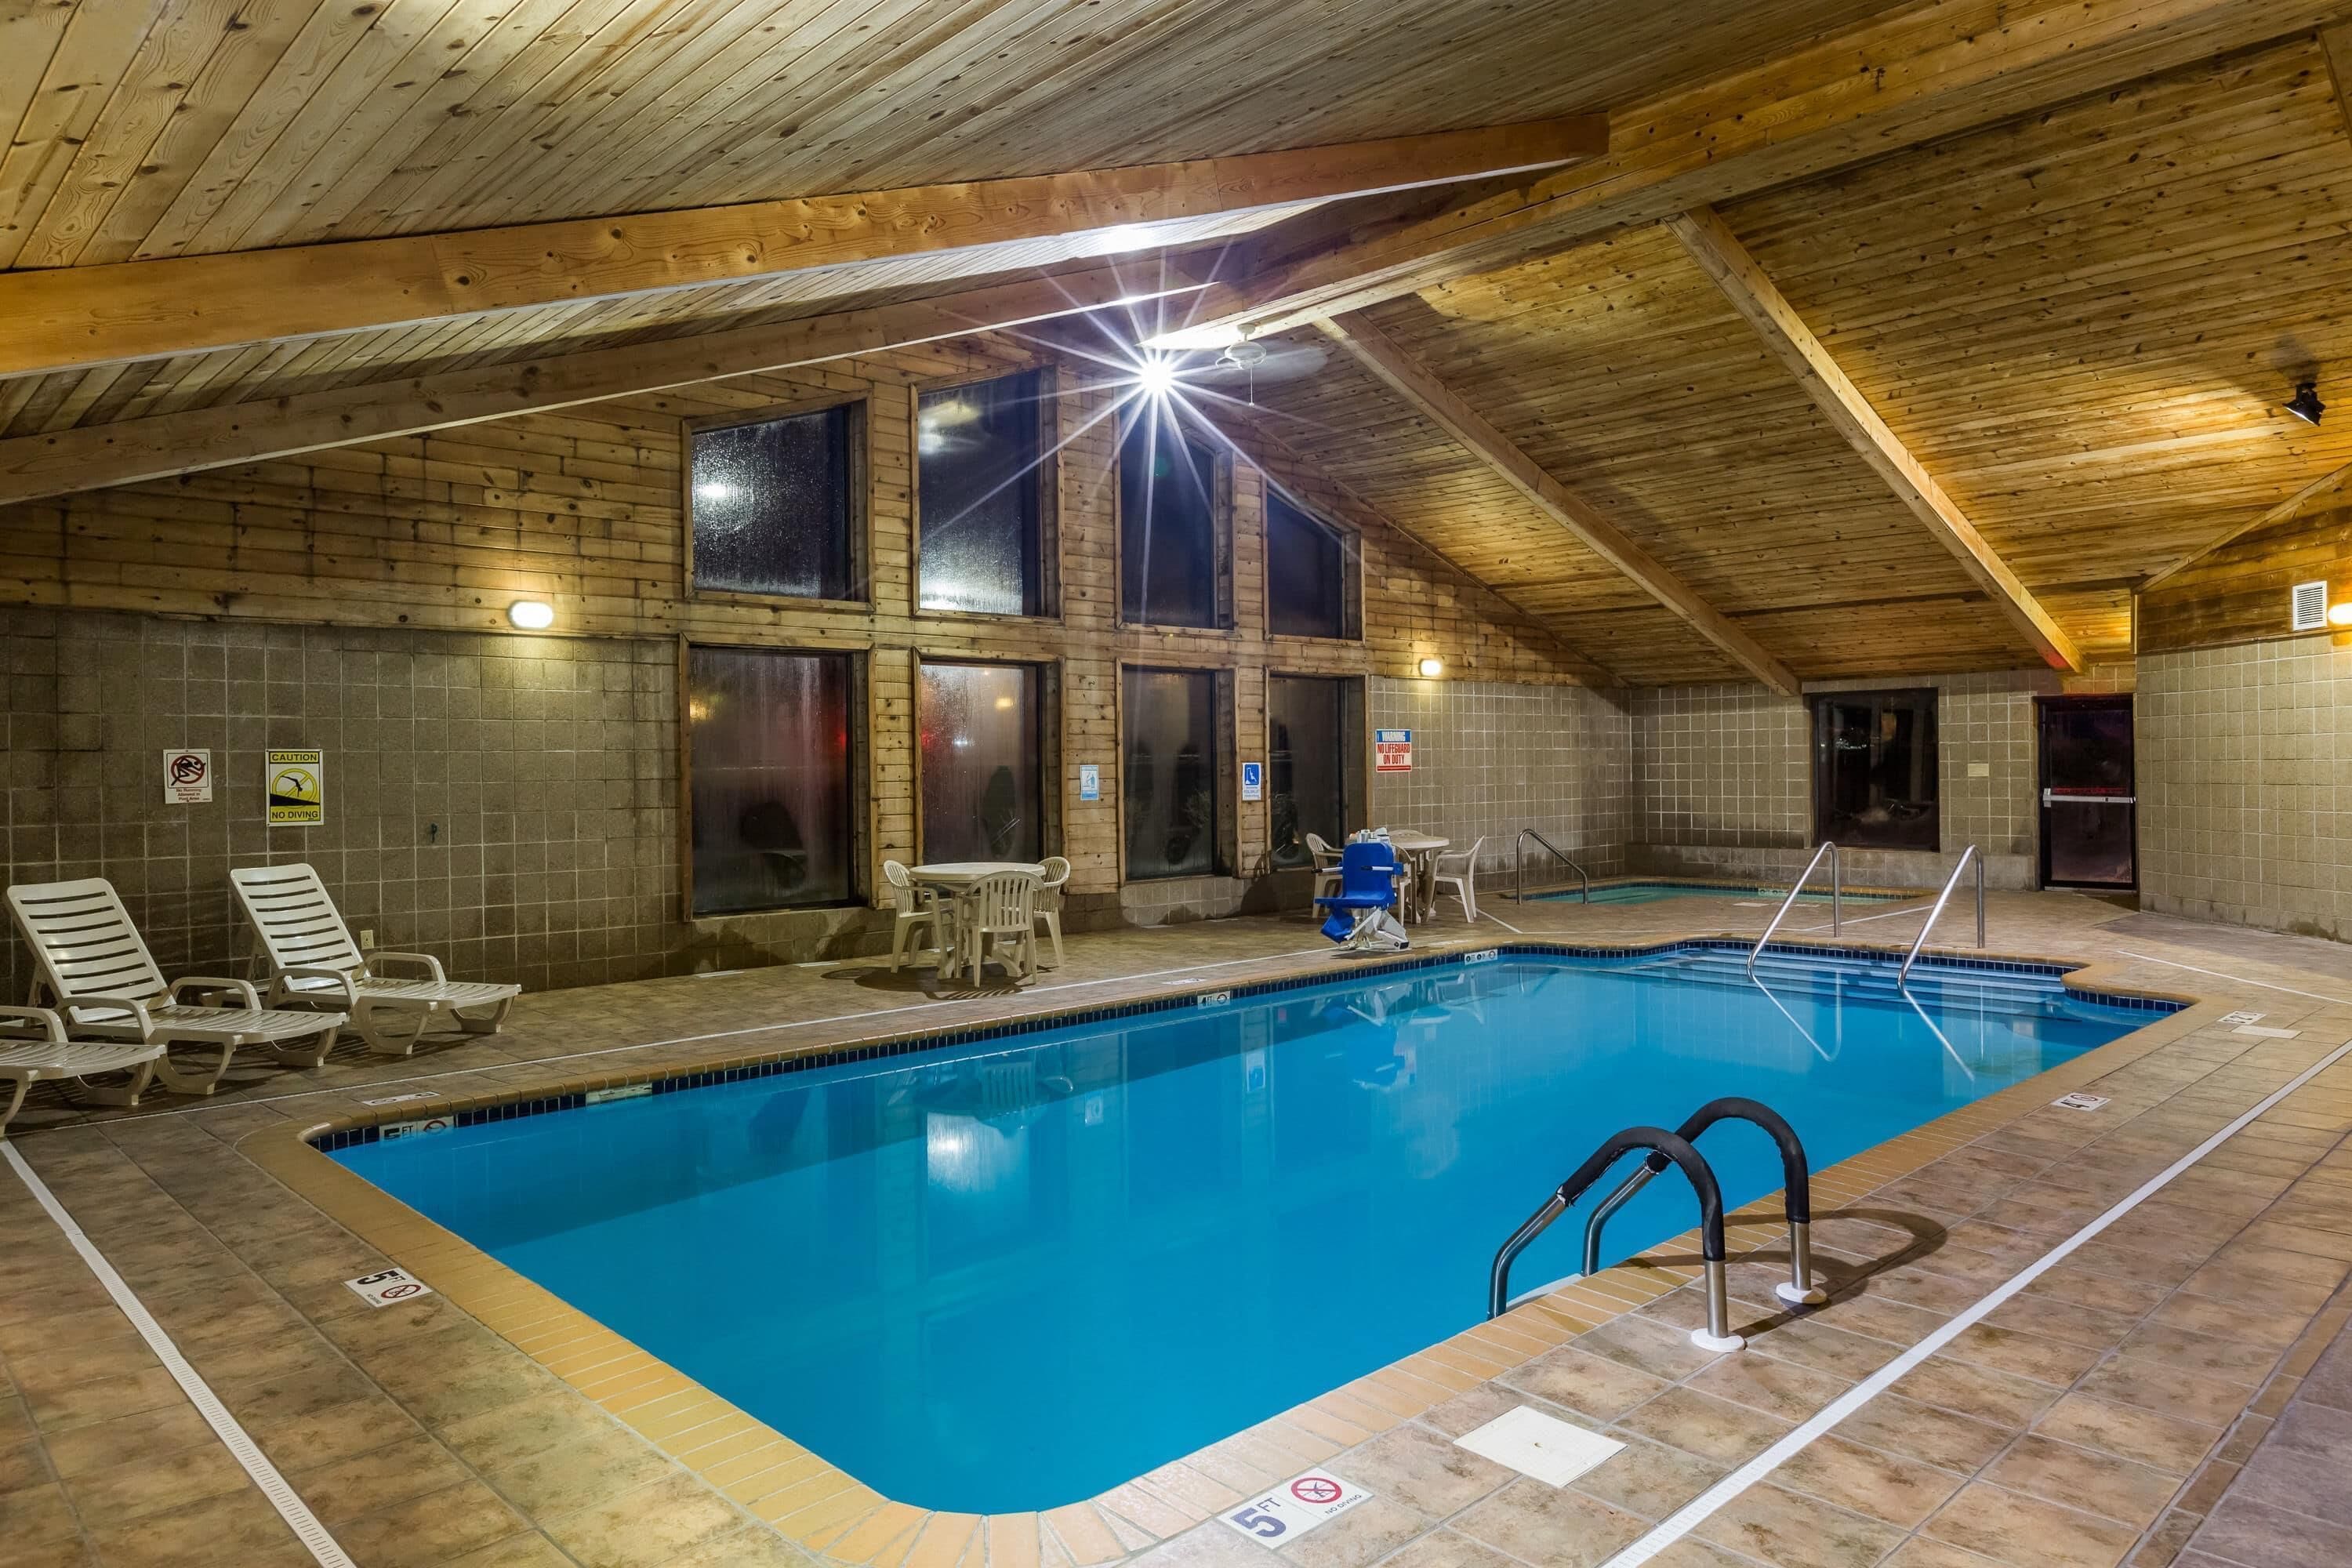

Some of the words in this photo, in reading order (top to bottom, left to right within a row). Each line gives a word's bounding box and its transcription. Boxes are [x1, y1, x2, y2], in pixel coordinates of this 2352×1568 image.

[1382, 731, 1405, 742] WARNING
[1377, 743, 1385, 753] NO
[1385, 743, 1410, 753] LIFEGUARD
[1384, 754, 1390, 764] ON
[1392, 754, 1404, 764] DUTY
[271, 811, 285, 819] NO
[288, 810, 318, 818] DIVING
[357, 1269, 400, 1285] 5
[1256, 1497, 1281, 1512] FT
[1325, 1505, 1338, 1515] NO
[1338, 1493, 1363, 1508] DIVING
[1229, 1507, 1287, 1537] 5
